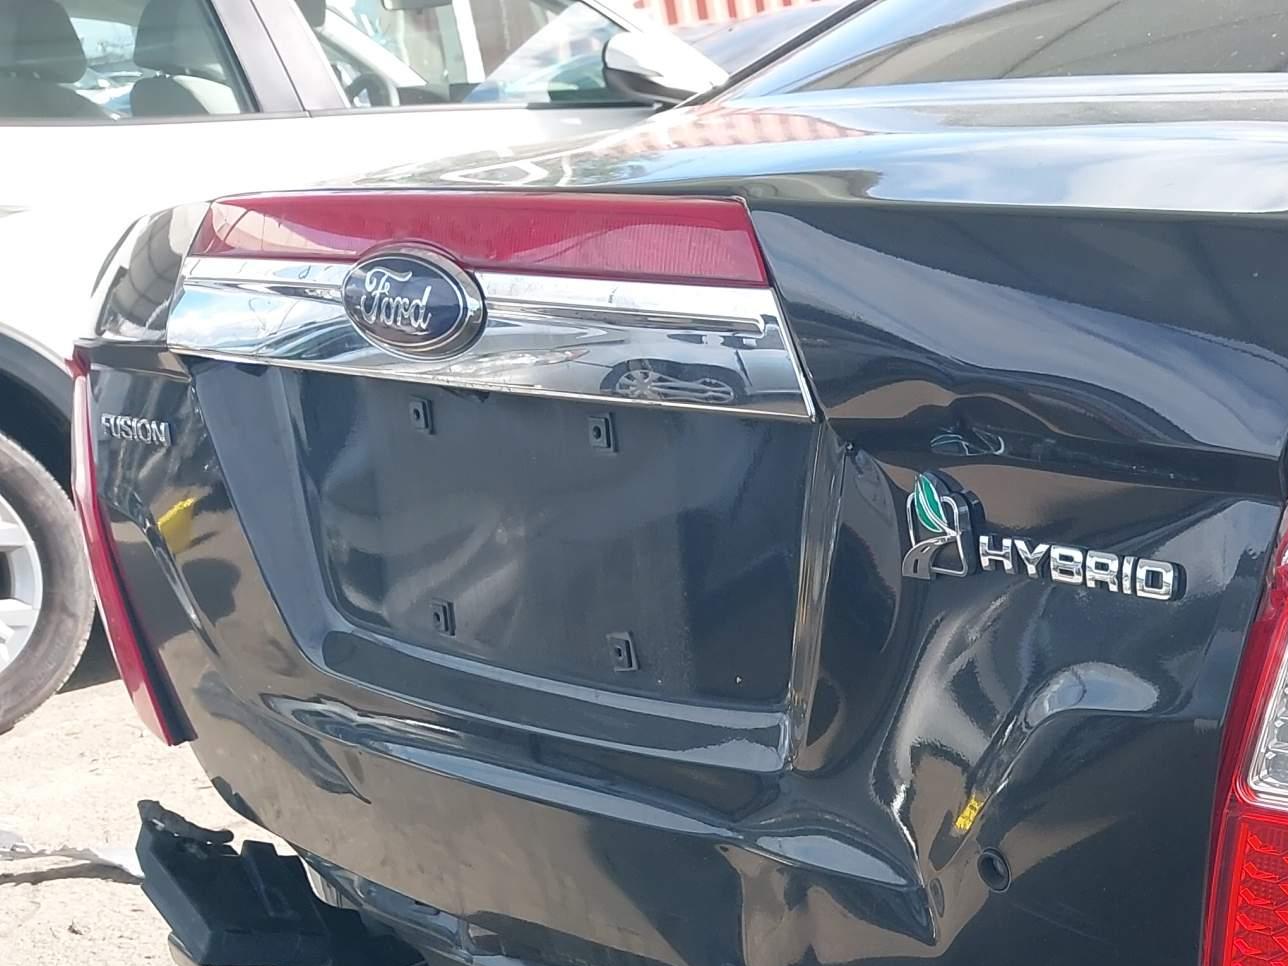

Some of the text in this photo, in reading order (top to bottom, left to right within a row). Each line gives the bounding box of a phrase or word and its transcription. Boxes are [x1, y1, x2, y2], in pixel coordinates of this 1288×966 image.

[361, 266, 433, 330] Ford
[101, 413, 171, 447] FUSION
[979, 535, 1180, 601] HYBRID
